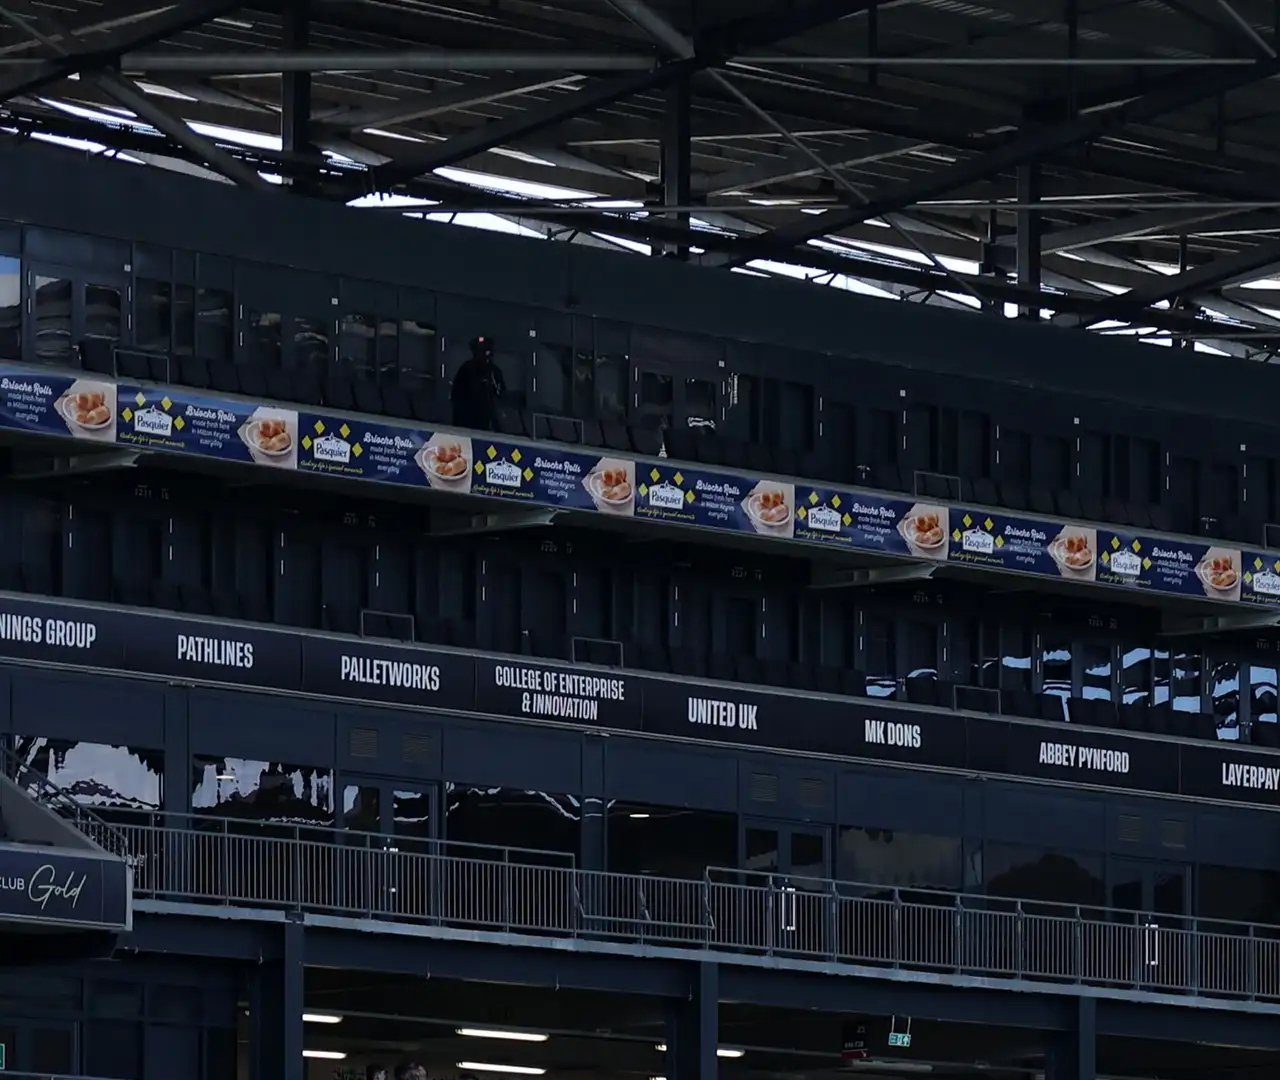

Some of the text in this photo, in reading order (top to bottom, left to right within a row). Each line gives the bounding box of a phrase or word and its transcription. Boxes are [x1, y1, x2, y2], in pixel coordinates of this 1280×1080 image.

[1, 378, 52, 395] Brioche Rolls
[186, 405, 236, 423] Brioche Rolls
[137, 415, 169, 431] Pasquier
[364, 432, 413, 448] Brioche Rolls
[316, 443, 347, 458] Pasquier
[534, 457, 581, 473] Brioche Rolls
[488, 467, 519, 482] Pasquier
[696, 479, 740, 495] Brioche Rolls
[652, 490, 681, 505] Pasquier
[852, 503, 896, 518] Brioche Rolls
[811, 513, 838, 527] Pasquier
[1005, 525, 1046, 540] Brioche Rolls
[965, 535, 991, 549] Pasquier
[1152, 547, 1193, 562] Brioche Rolls
[1113, 557, 1138, 572] Pasquier
[1255, 578, 1280, 592] Pasquier
[0, 612, 97, 649] NINGS GROUP
[176, 634, 254, 668] PATHLINES
[341, 655, 440, 691] PALLETWORKS
[495, 665, 625, 700] COLLEGE OF ENTERPRISE
[521, 692, 599, 721] & INNOVATION
[688, 697, 758, 730] UNITED UK
[864, 719, 922, 748] MK DONS
[1038, 741, 1130, 774] ABBEY PYNFORD
[1222, 762, 1280, 791] LAYERPAY
[0, 864, 87, 911] LUB Gold
